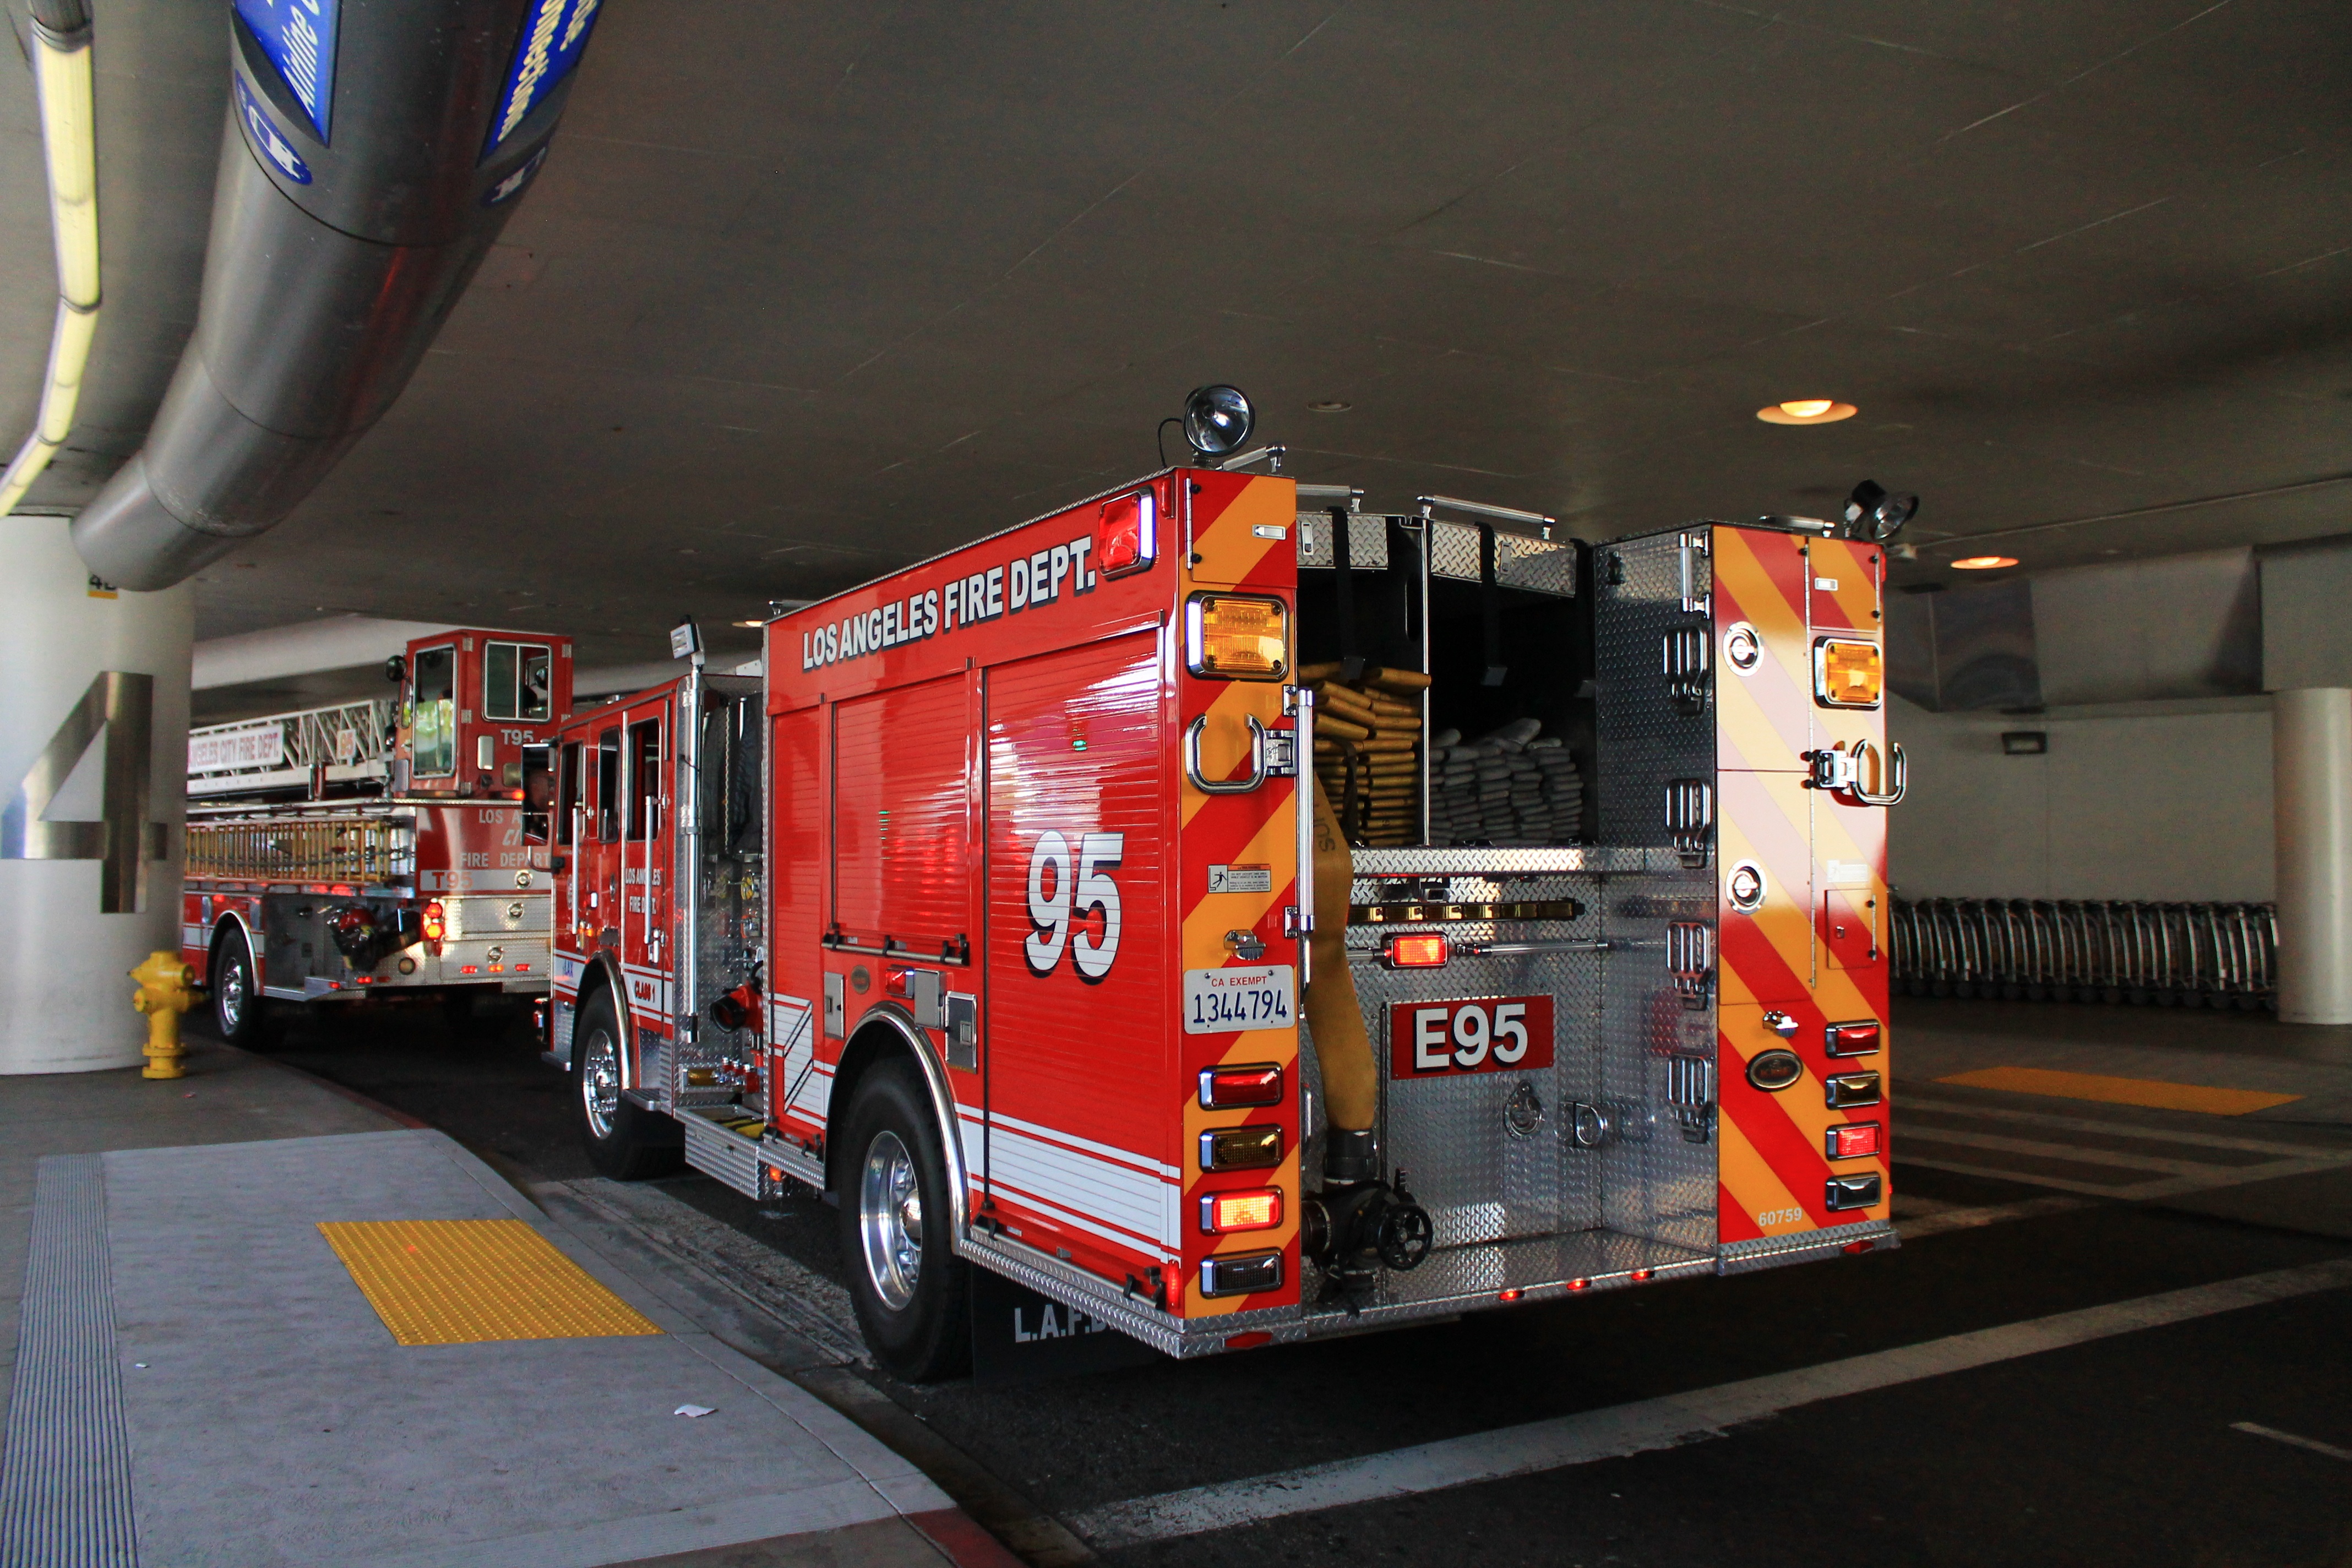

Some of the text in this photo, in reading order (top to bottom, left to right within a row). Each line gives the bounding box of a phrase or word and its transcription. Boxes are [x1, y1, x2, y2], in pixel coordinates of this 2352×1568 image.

[282, 5, 318, 119] Airline
[802, 536, 1096, 670] LOS ANGELES FIRE DEPT.
[500, 728, 534, 745] T95
[239, 736, 255, 761] FIRE
[0, 671, 167, 913] 4
[478, 809, 503, 824] LOS
[460, 852, 489, 867] FIRE
[432, 871, 474, 890] T95
[625, 868, 635, 885] LOS
[629, 895, 641, 913] FIRE
[1025, 830, 1124, 978] 95
[1211, 976, 1267, 987] CA EXEMPT
[1193, 989, 1287, 1023] 1344794
[1414, 1003, 1528, 1069] E95
[1758, 1207, 1803, 1227] 60759
